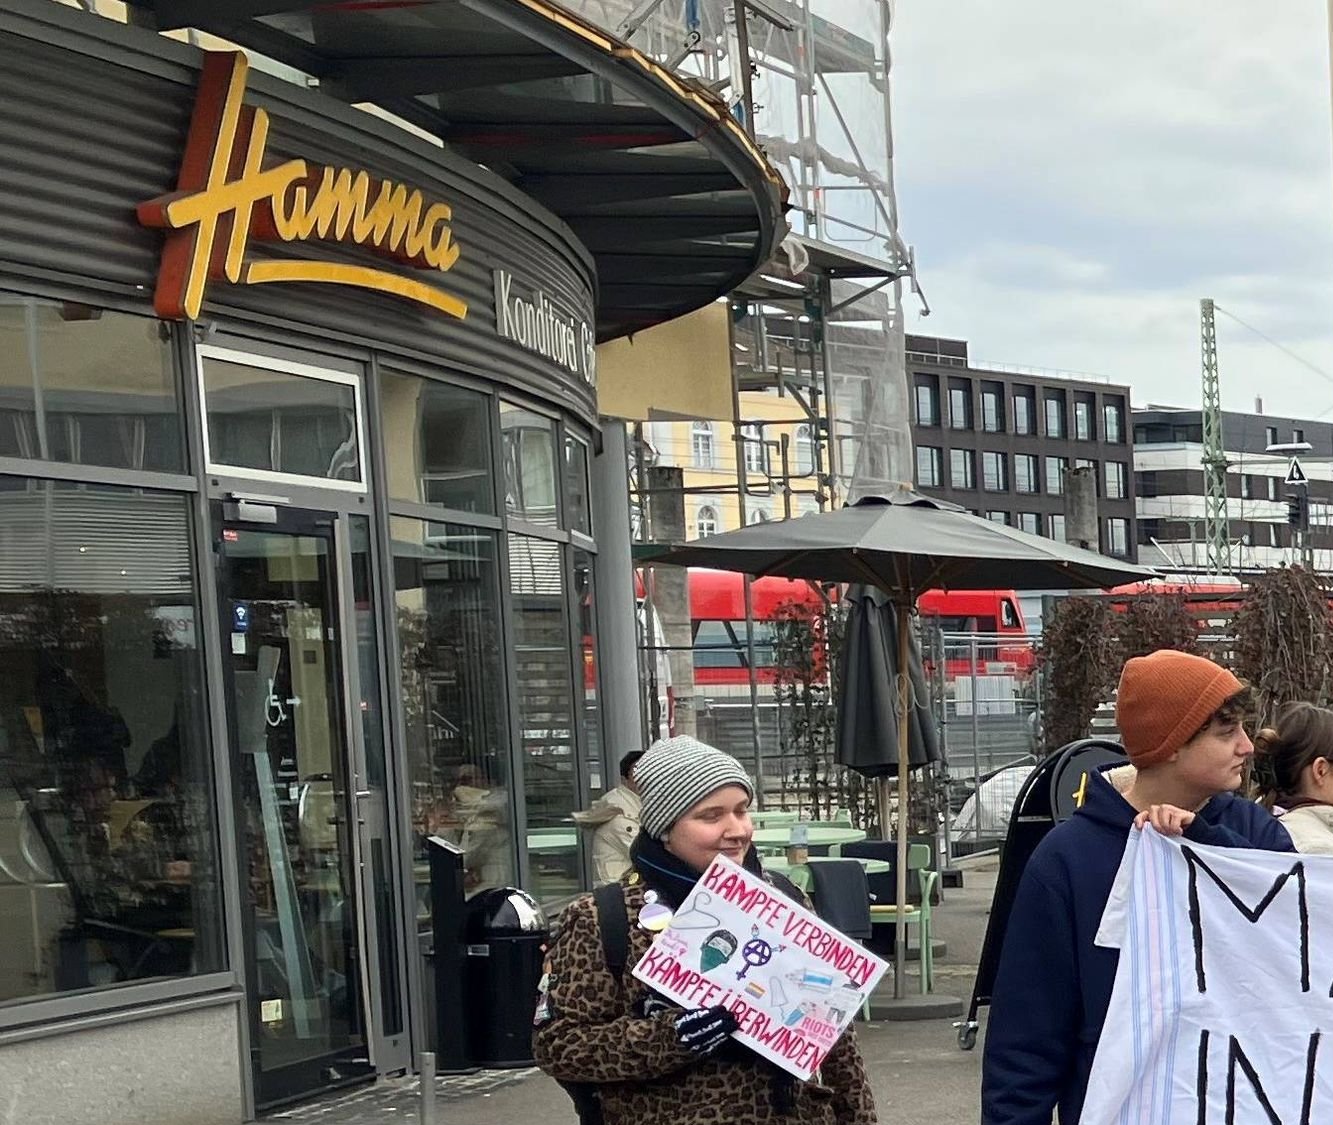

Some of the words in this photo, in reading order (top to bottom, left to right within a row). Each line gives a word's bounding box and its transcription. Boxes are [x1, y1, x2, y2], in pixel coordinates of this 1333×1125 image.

[166, 51, 460, 320] Hamma
[500, 270, 578, 372] Konditorei
[638, 947, 721, 1011] KÄMPFE
[783, 911, 876, 987] VERBINDEN
[802, 1015, 836, 1039] RIOTS
